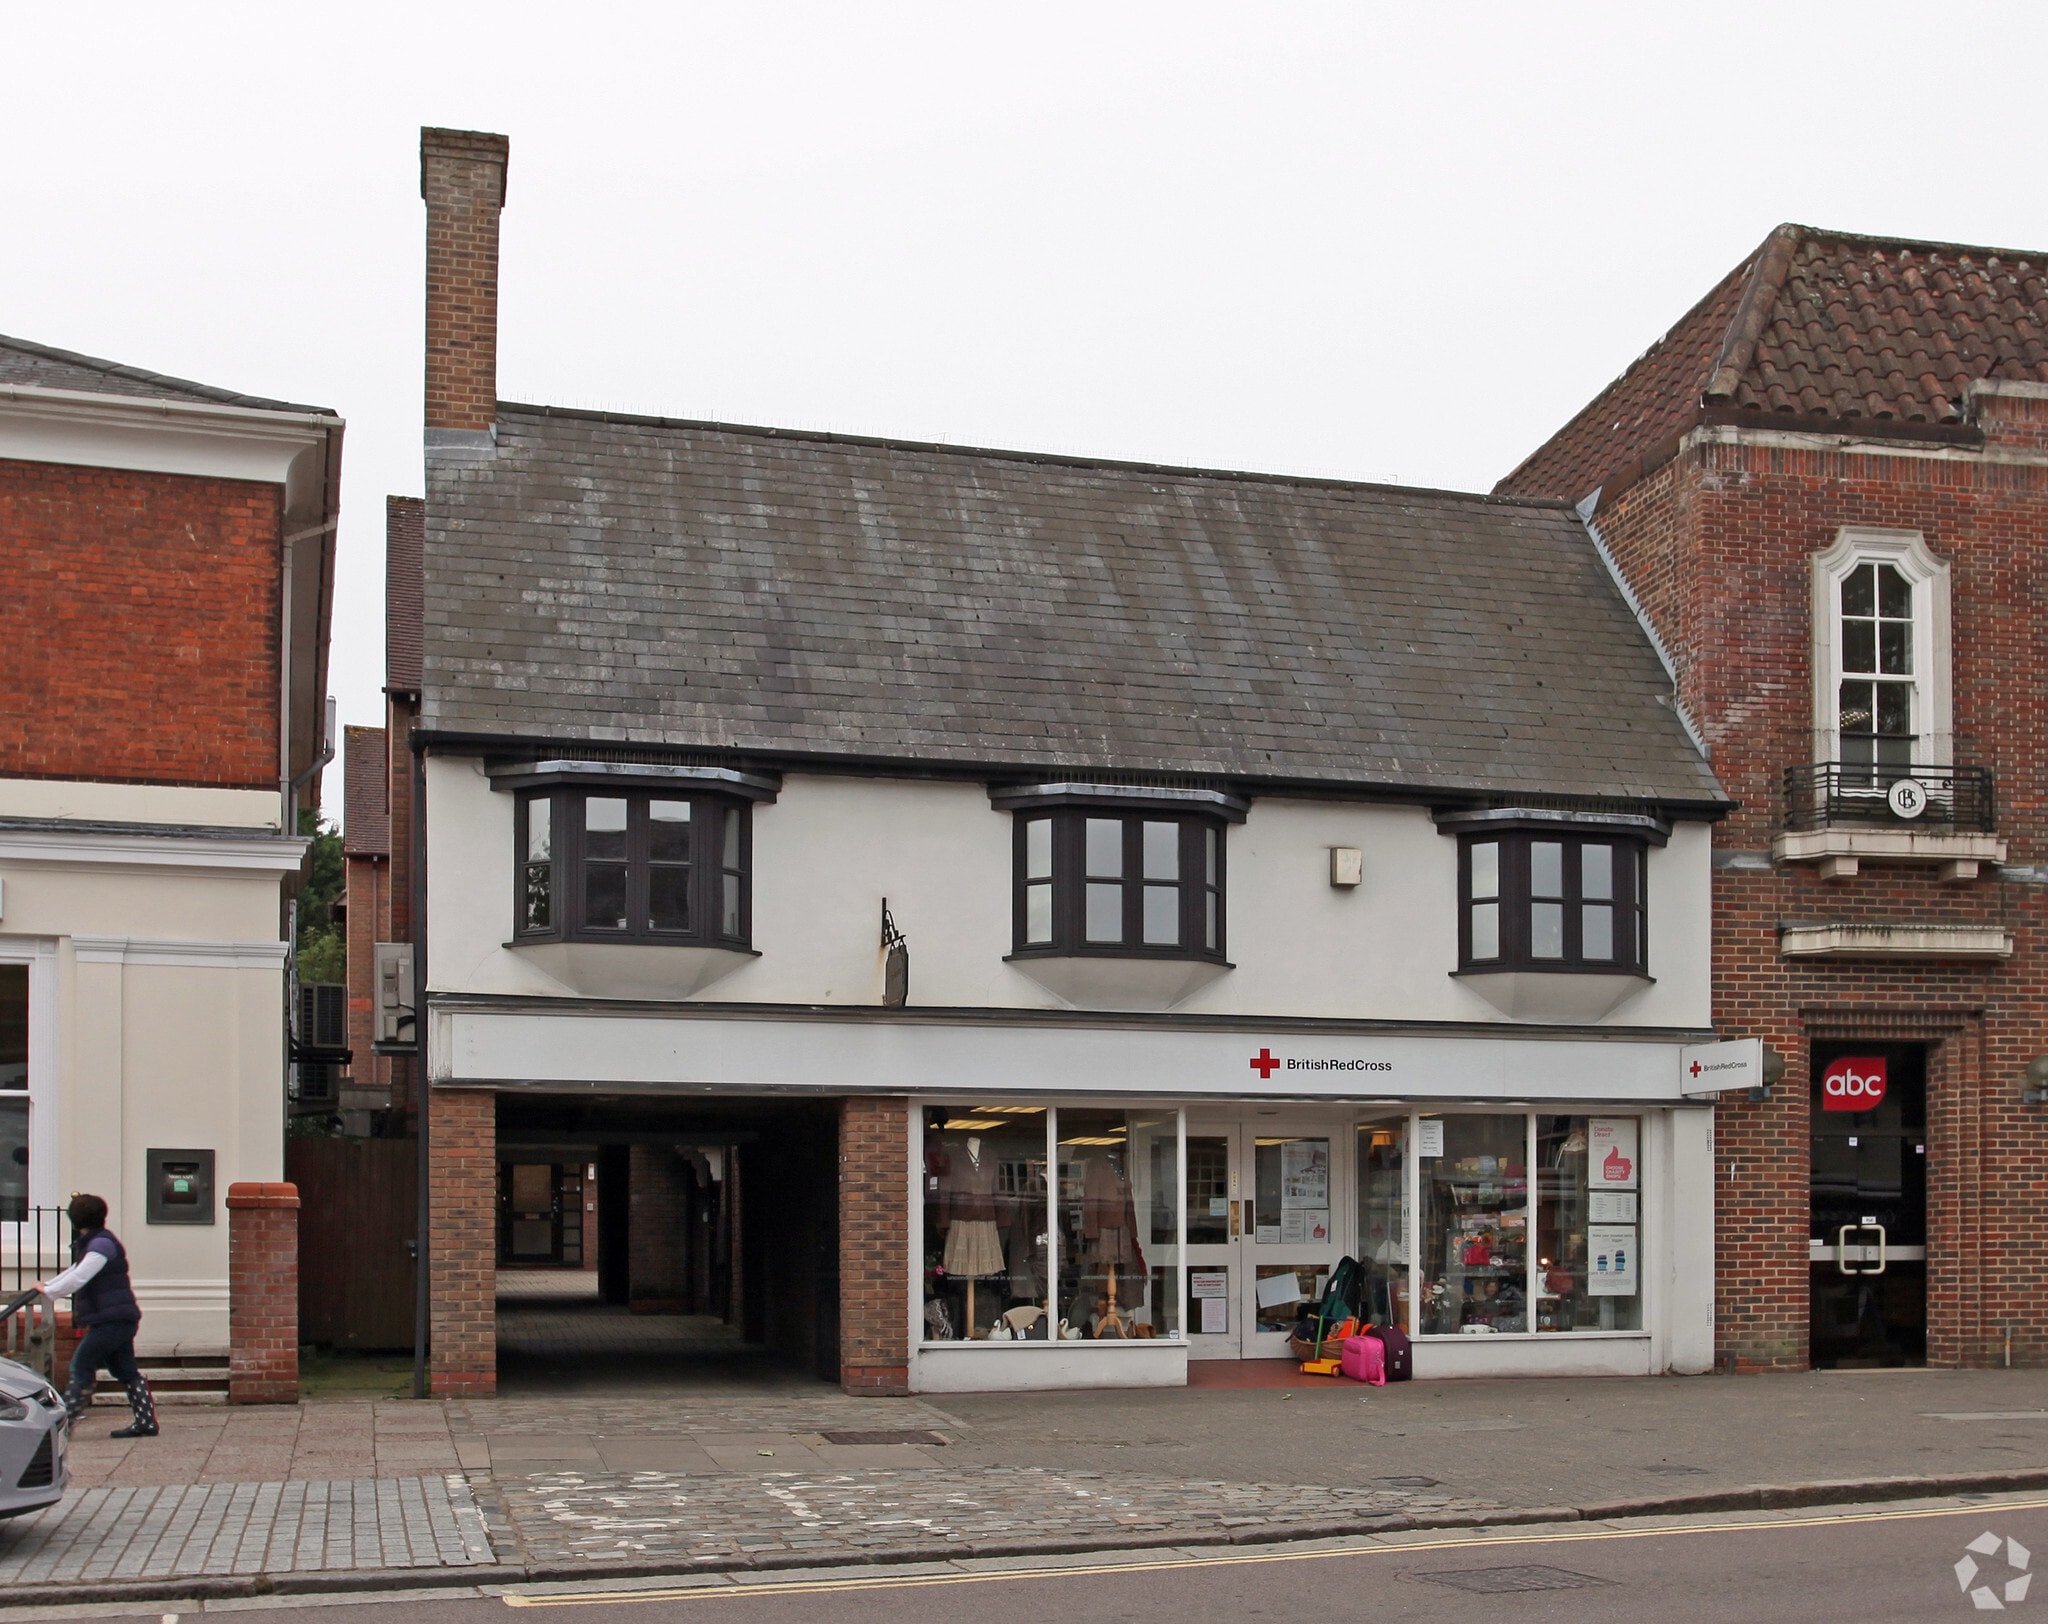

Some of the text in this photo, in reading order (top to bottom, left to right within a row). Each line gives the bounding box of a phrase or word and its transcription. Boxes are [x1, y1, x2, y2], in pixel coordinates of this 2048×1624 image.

[1287, 1058, 1392, 1071] BritishRedCross
[1703, 1062, 1748, 1072] BritishRedCross
[1825, 1067, 1882, 1096] abc
